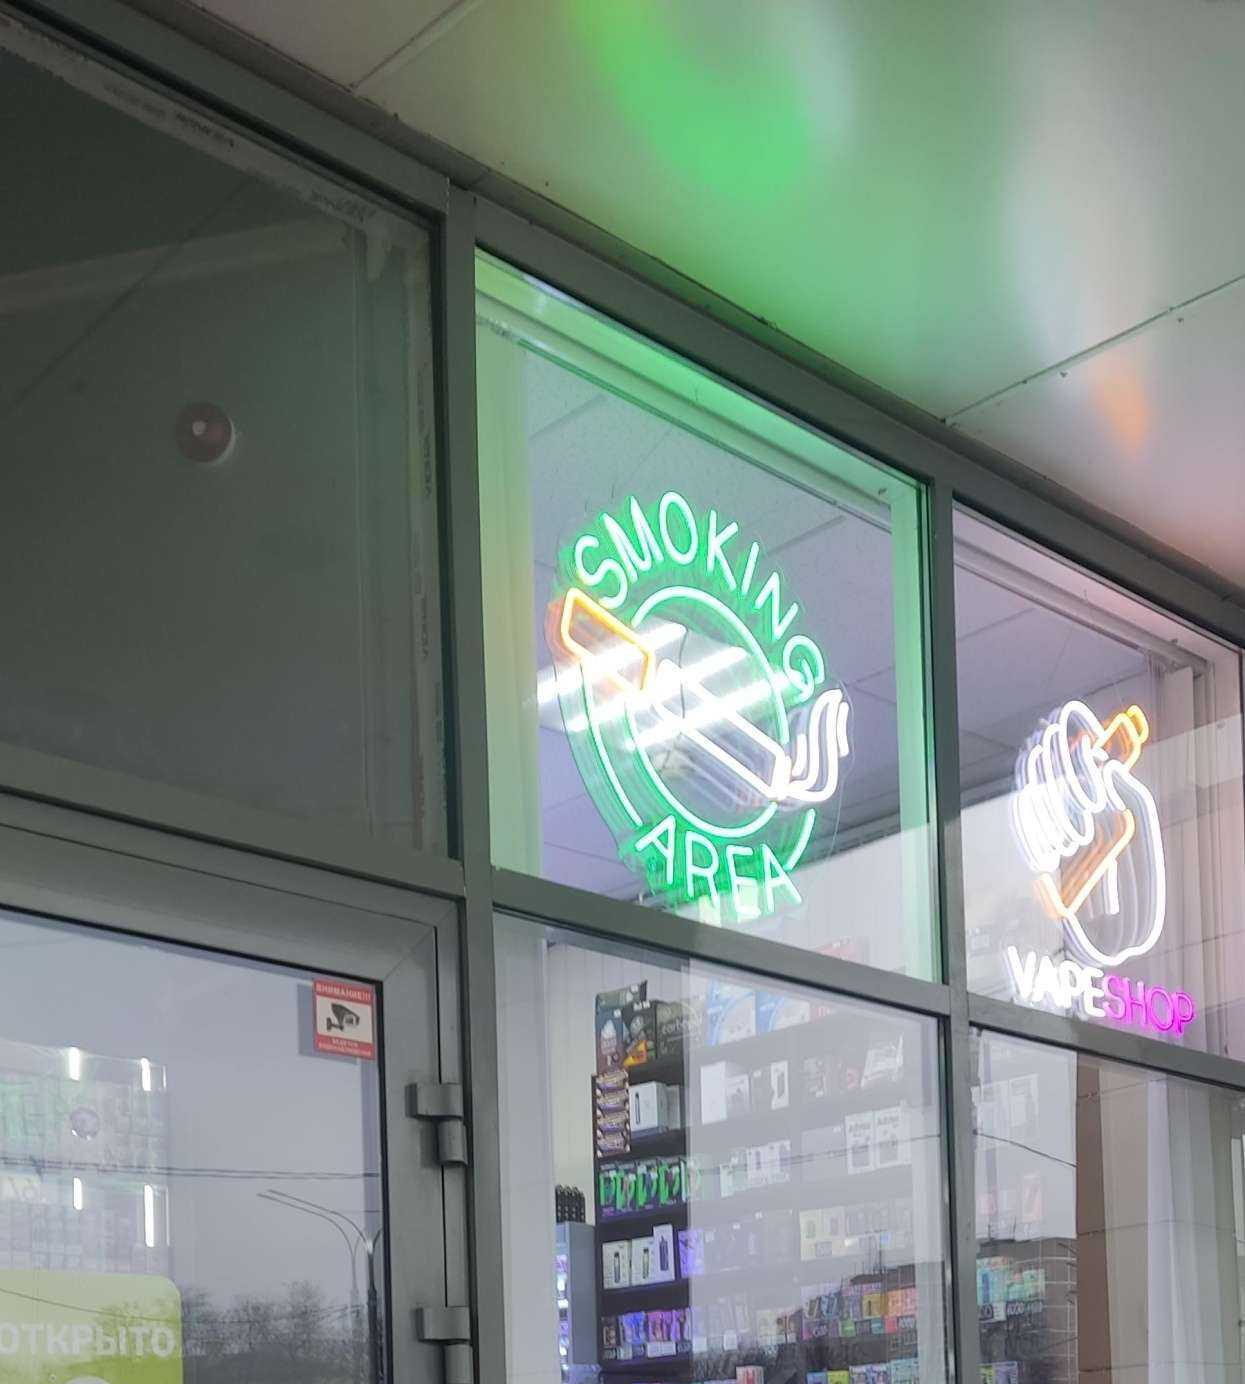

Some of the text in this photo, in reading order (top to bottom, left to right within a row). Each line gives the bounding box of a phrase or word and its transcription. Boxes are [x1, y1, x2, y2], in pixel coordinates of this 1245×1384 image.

[574, 491, 826, 704] SMOKING
[635, 815, 804, 914] AREA
[0, 1322, 177, 1358] ОТКРЫТО
